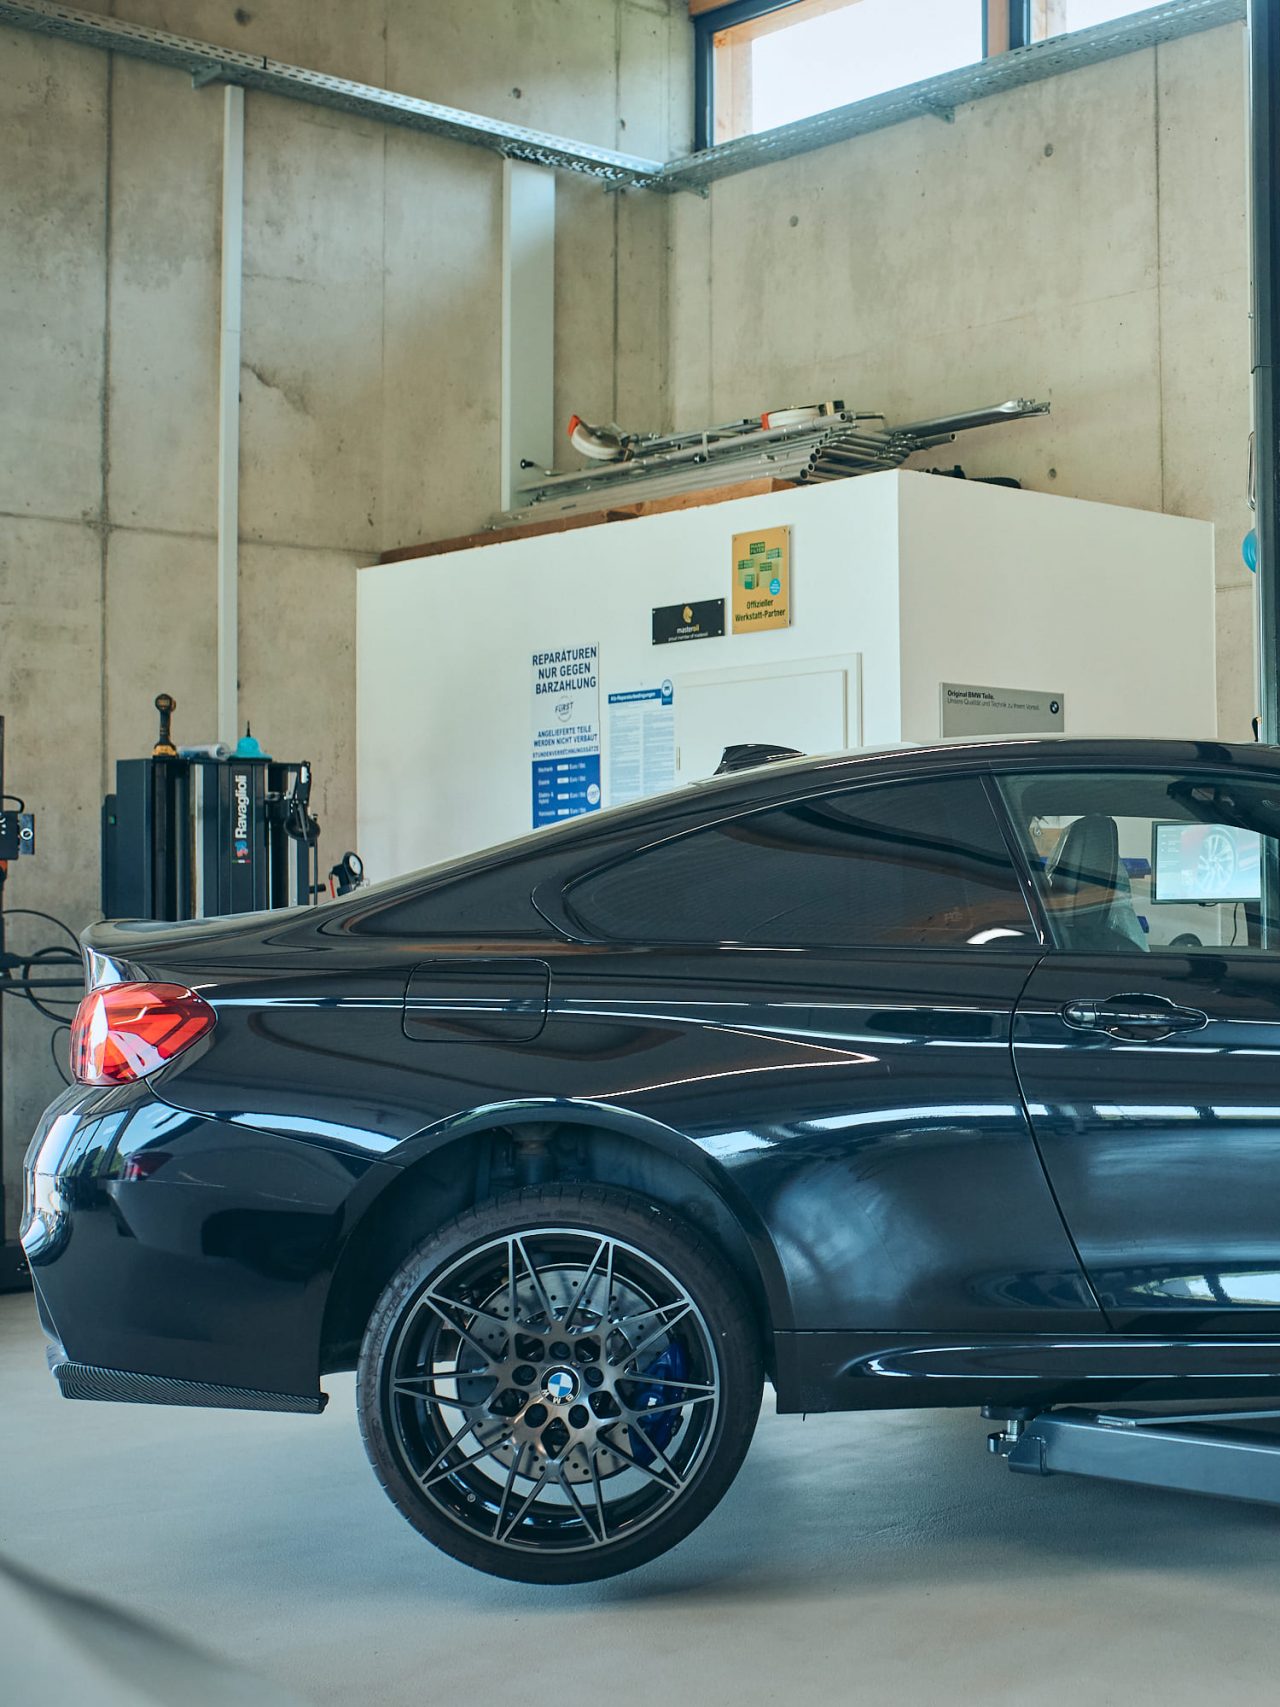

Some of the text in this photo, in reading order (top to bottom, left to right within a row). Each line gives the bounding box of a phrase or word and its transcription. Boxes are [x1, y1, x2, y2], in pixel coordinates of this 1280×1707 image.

[746, 599, 774, 609] Offizieller
[735, 609, 786, 622] Werkstatt-Partner
[676, 624, 700, 634] masteroil
[532, 646, 597, 666] REPARATUREN
[538, 662, 590, 680] NUR GEGEN
[535, 676, 597, 695] BARZAHLUNG
[947, 689, 967, 699] Original
[968, 690, 981, 699] BMW
[538, 725, 591, 738] ANGELIEFERTE TEILE
[533, 733, 598, 748] WERDEN NICHT VERBAUT
[234, 775, 250, 839] Ravaglioli
